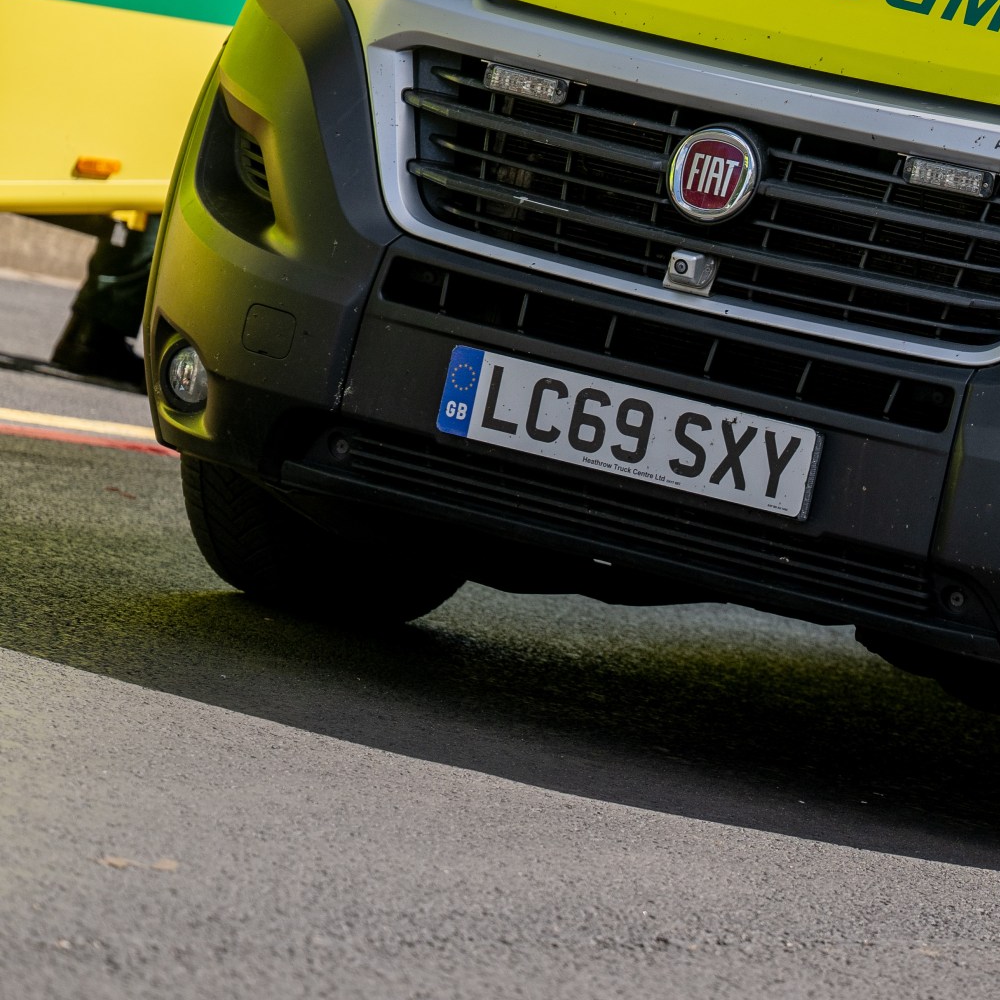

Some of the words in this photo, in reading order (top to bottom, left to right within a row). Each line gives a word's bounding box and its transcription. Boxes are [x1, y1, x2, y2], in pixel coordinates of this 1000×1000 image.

[686, 152, 740, 198] FIAT
[445, 400, 468, 421] GB
[481, 365, 655, 464] LC69
[668, 411, 802, 499] SXY
[582, 455, 613, 470] Heathrow
[613, 463, 632, 474] Truck
[632, 467, 654, 480] Centre
[654, 473, 666, 482] Ltd
